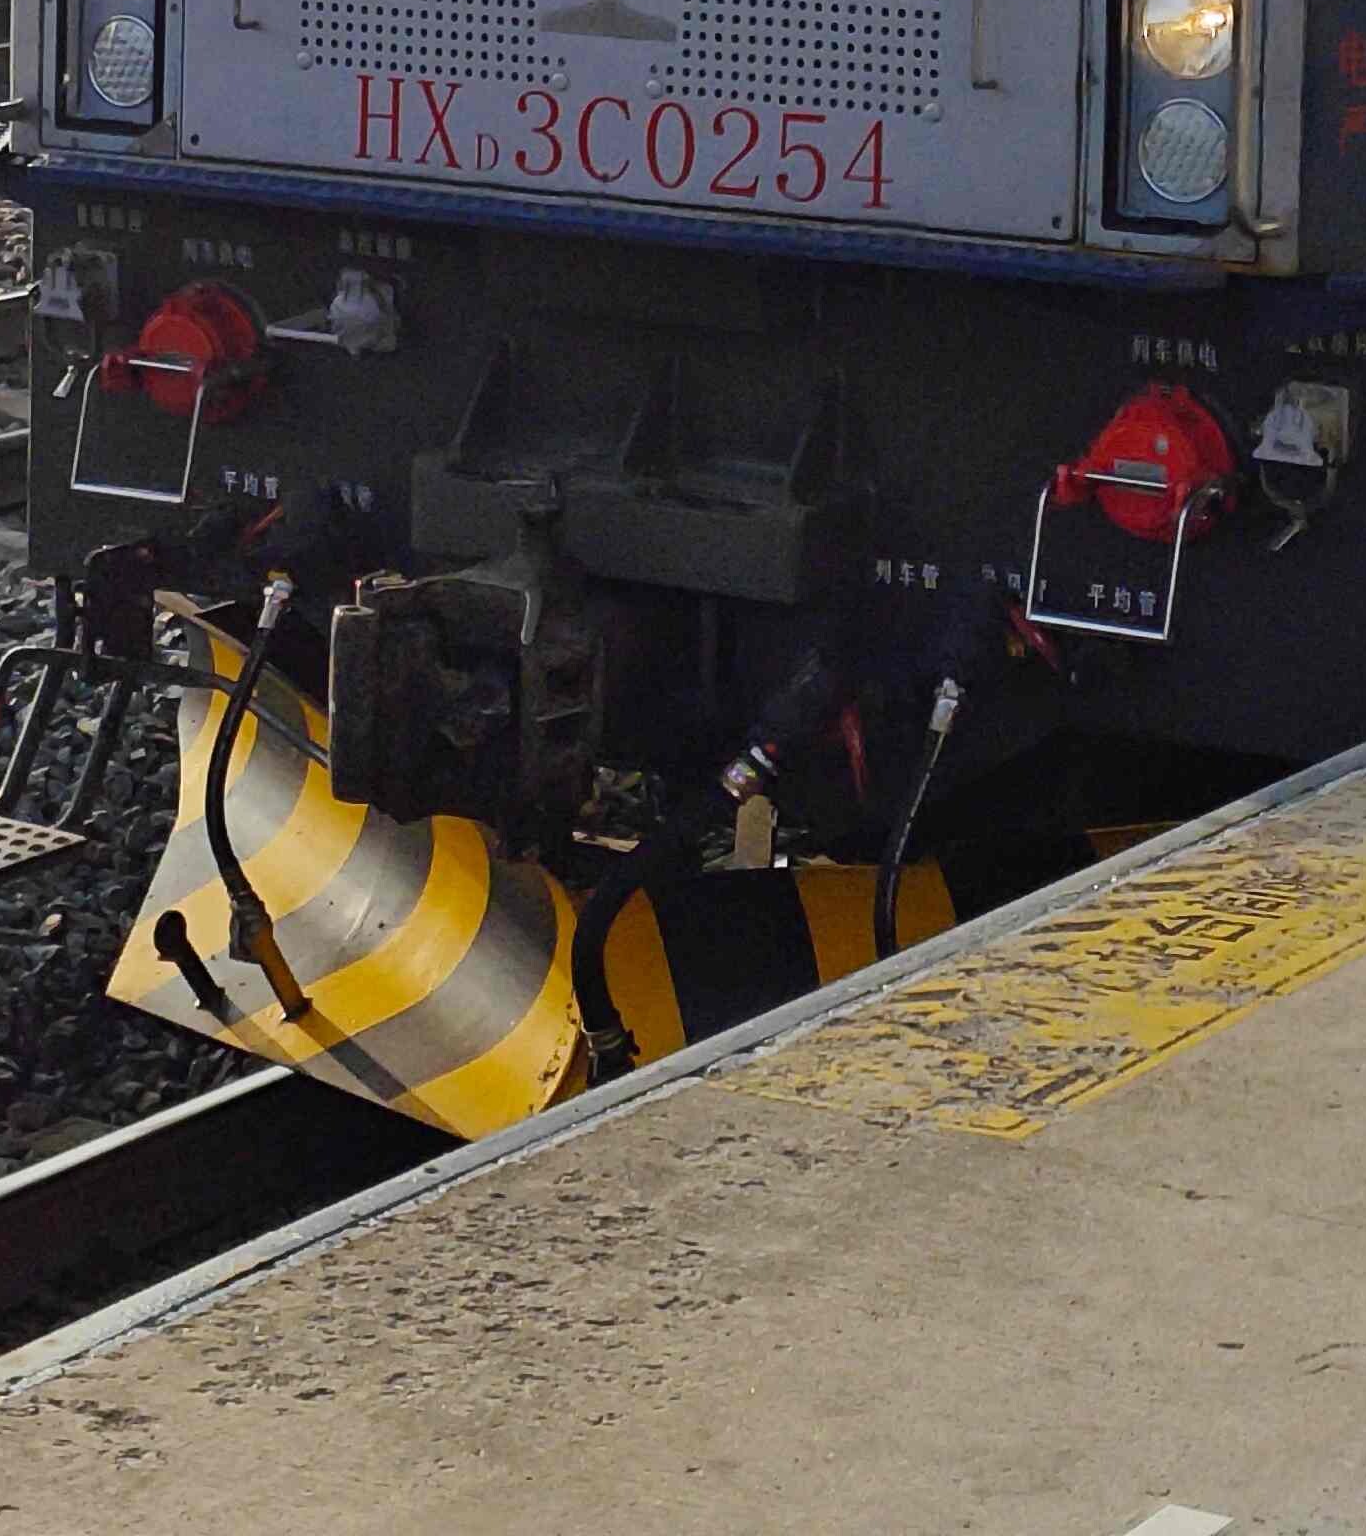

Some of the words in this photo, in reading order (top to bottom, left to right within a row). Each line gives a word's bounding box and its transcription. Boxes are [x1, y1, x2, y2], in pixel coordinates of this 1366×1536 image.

[353, 74, 894, 210] HXD3C0254
[875, 559, 940, 590] 列车管
[1088, 583, 1157, 617] 平均管
